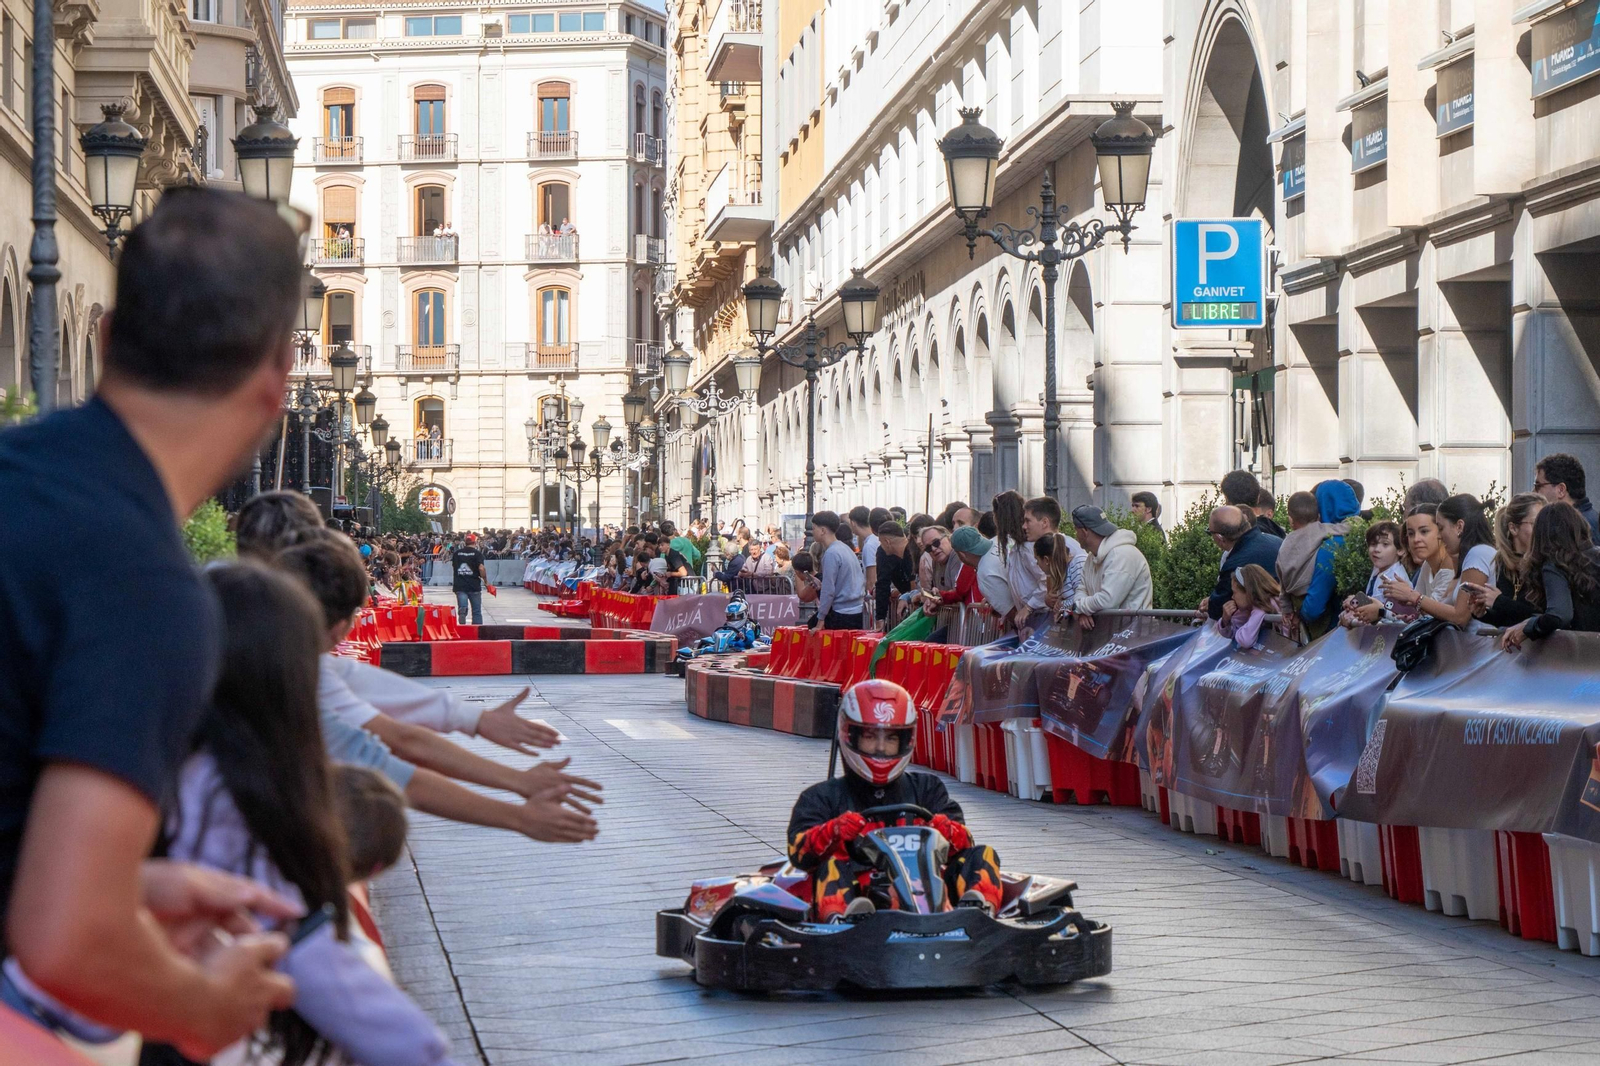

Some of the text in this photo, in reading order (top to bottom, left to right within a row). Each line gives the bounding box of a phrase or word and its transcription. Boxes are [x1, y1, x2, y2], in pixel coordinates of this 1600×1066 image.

[1198, 223, 1240, 285] P
[1193, 286, 1246, 297] GANIVET
[1192, 303, 1241, 320] LIBRE
[1464, 718, 1567, 745] RS50 Y A50 X MCLAREN
[888, 834, 921, 852] 26
